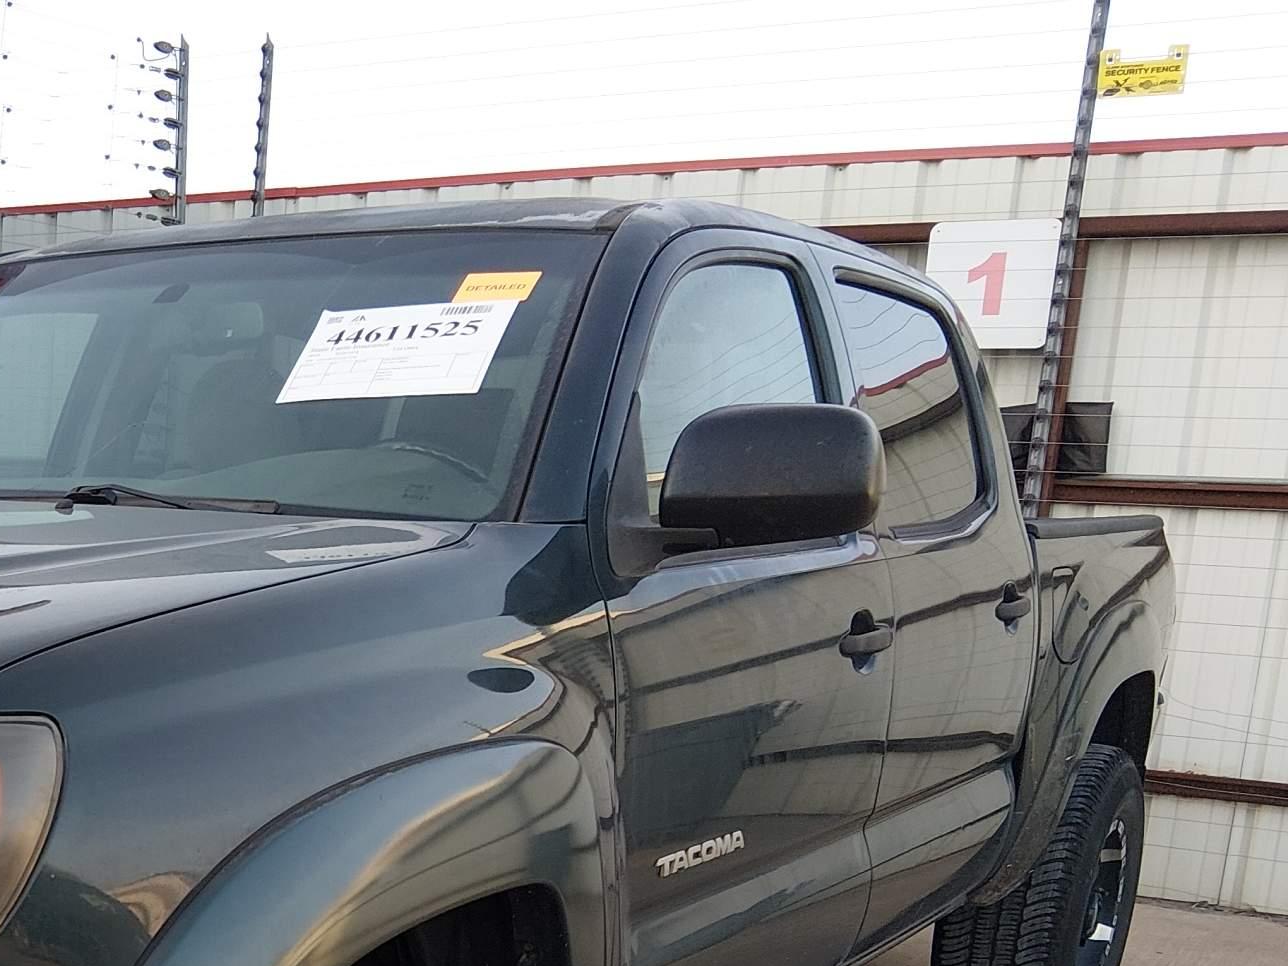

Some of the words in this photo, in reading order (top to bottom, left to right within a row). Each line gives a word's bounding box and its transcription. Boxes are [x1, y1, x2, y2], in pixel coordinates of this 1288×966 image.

[1104, 67, 1149, 77] SECURITY
[1151, 64, 1182, 74] FENCE
[465, 282, 528, 292] DETAILED
[967, 251, 1008, 316] 1
[326, 319, 483, 346] 44611525
[655, 829, 745, 878] TACOMA
